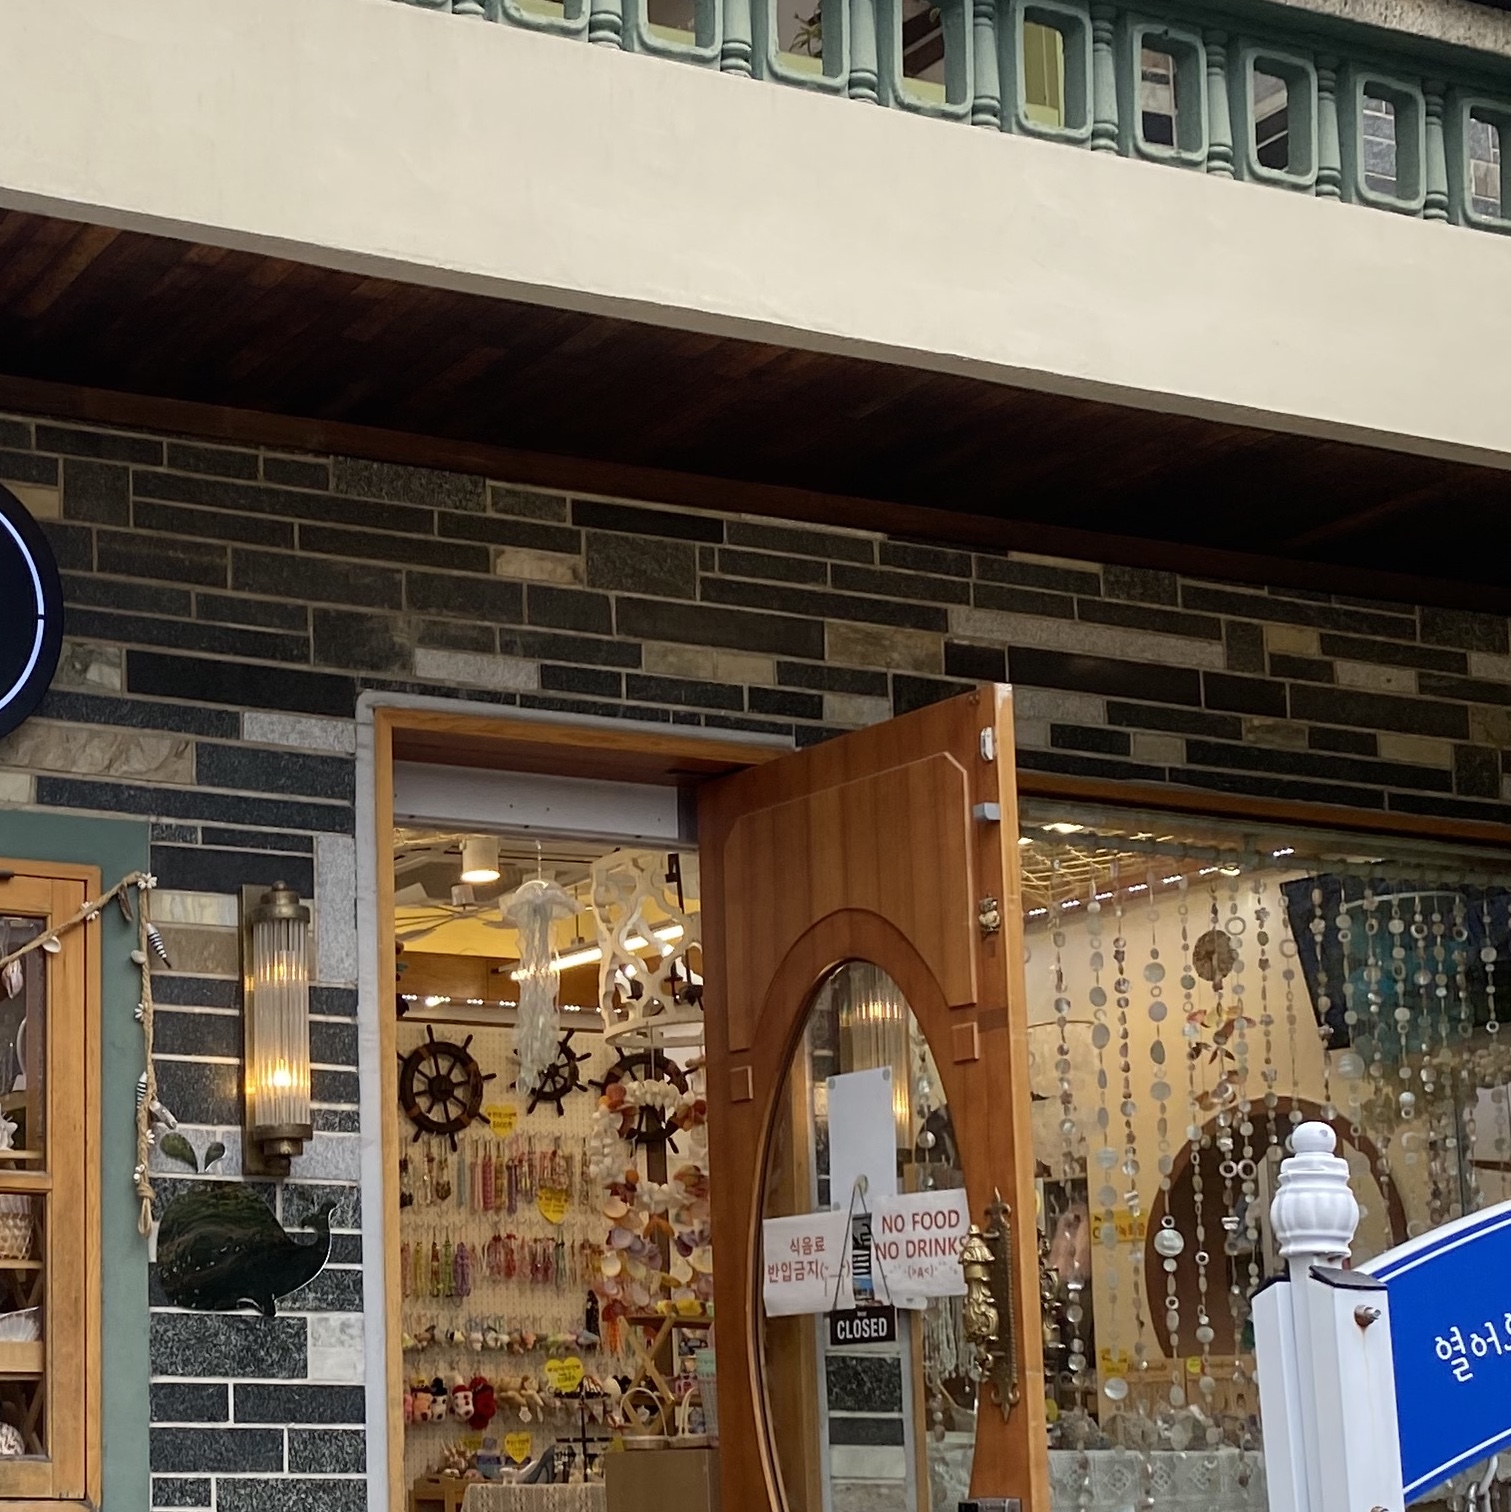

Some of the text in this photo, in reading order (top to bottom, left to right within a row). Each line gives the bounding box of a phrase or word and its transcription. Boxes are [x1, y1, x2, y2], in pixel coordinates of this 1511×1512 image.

[882, 1209, 960, 1234] NO FOOD
[790, 1236, 825, 1257] 식음료
[876, 1242, 899, 1260] NO
[837, 1317, 888, 1340] CLOSED
[1435, 1313, 1511, 1382] 열어
